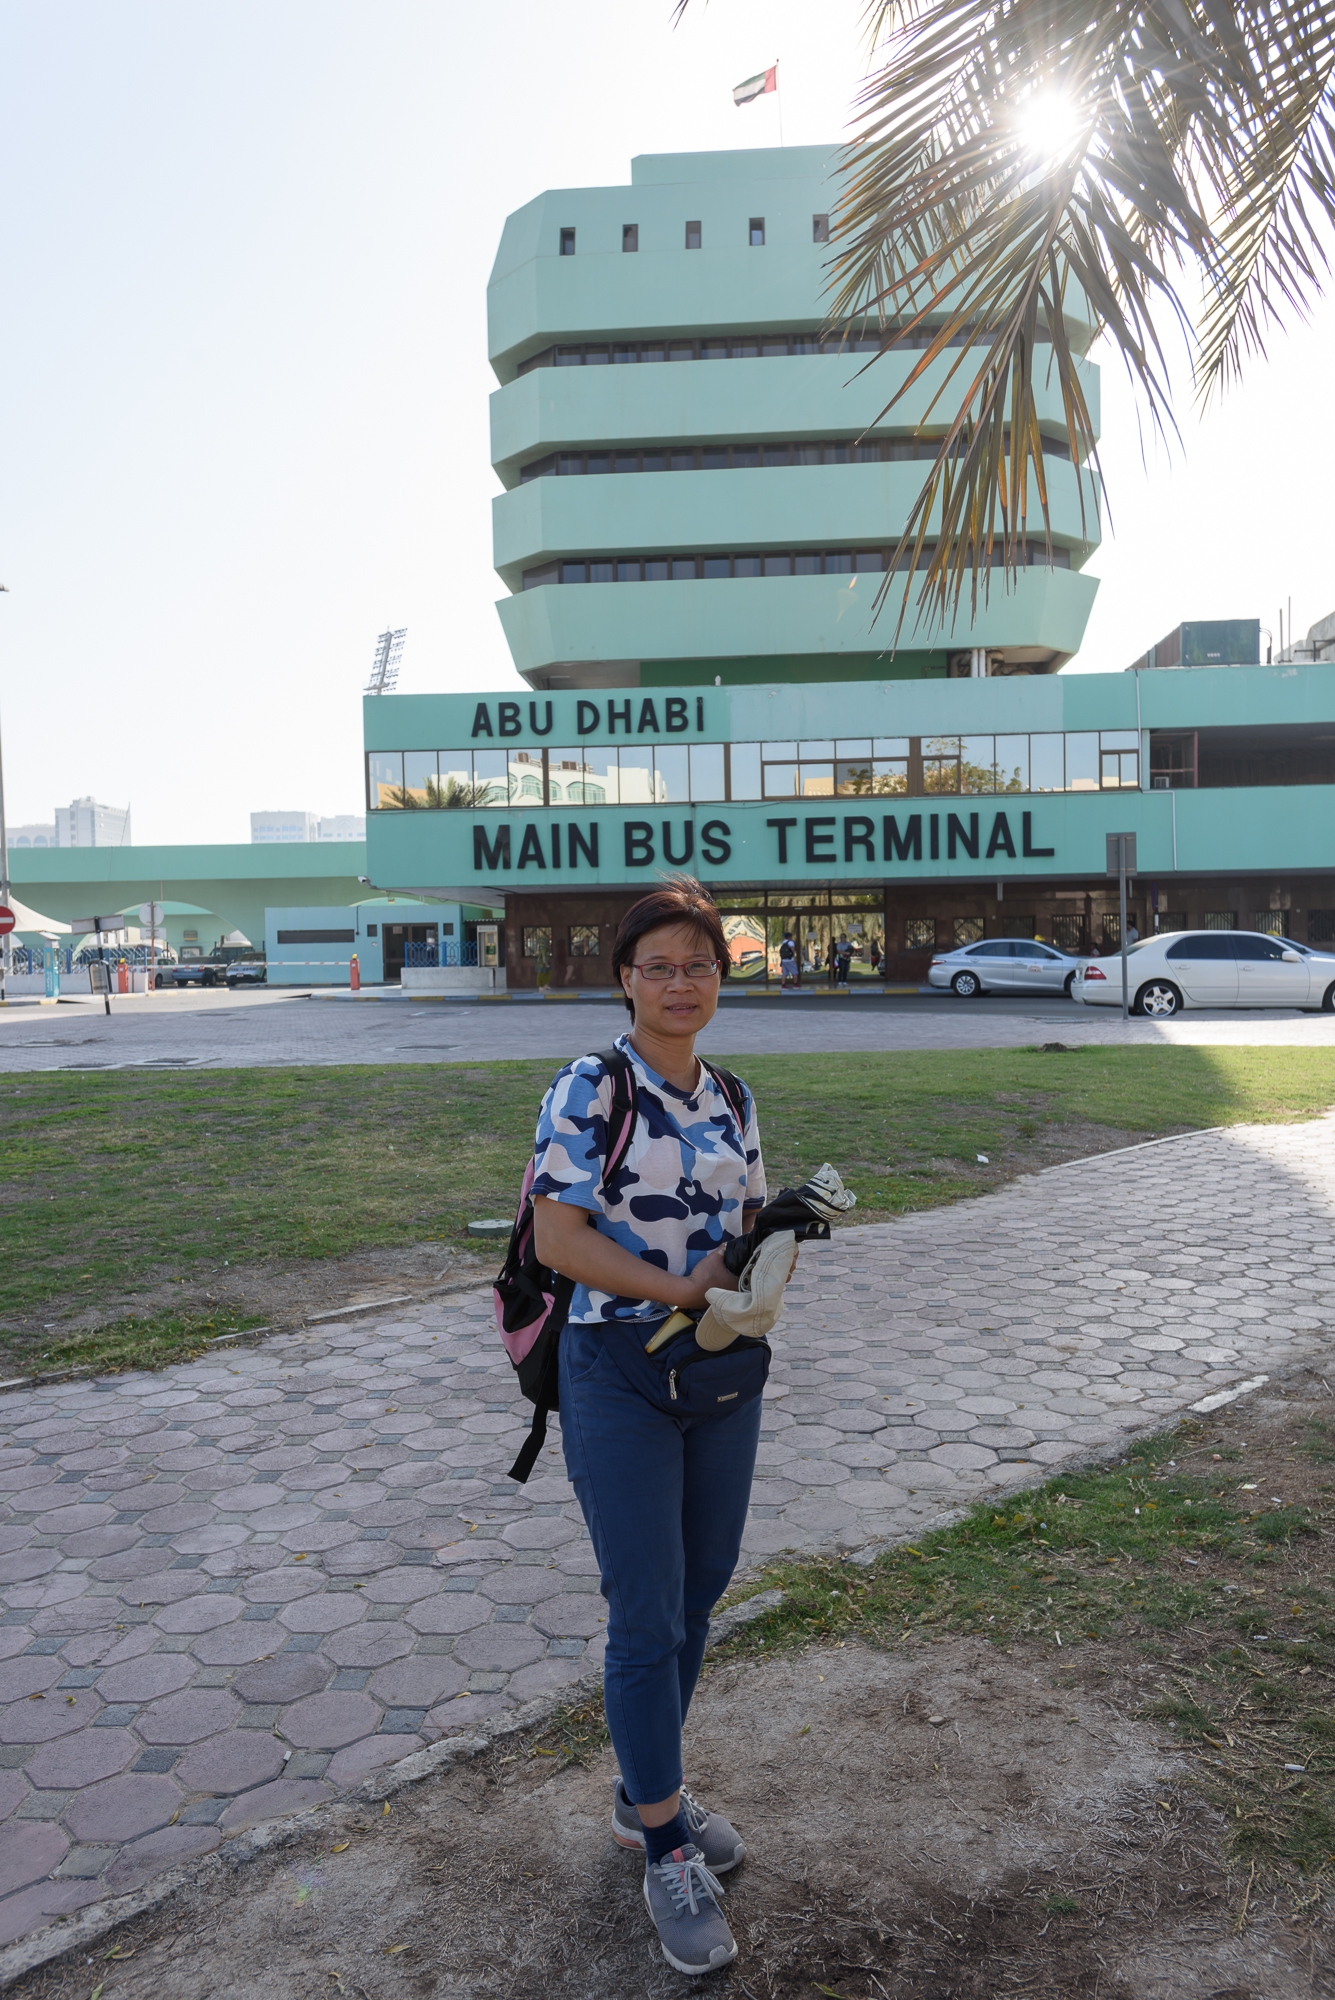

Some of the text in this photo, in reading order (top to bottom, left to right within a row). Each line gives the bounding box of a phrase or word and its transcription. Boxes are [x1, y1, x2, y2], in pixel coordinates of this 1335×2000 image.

[470, 696, 705, 738] ABU DHABI
[472, 810, 1056, 871] MAIN BUS TERMINAL
